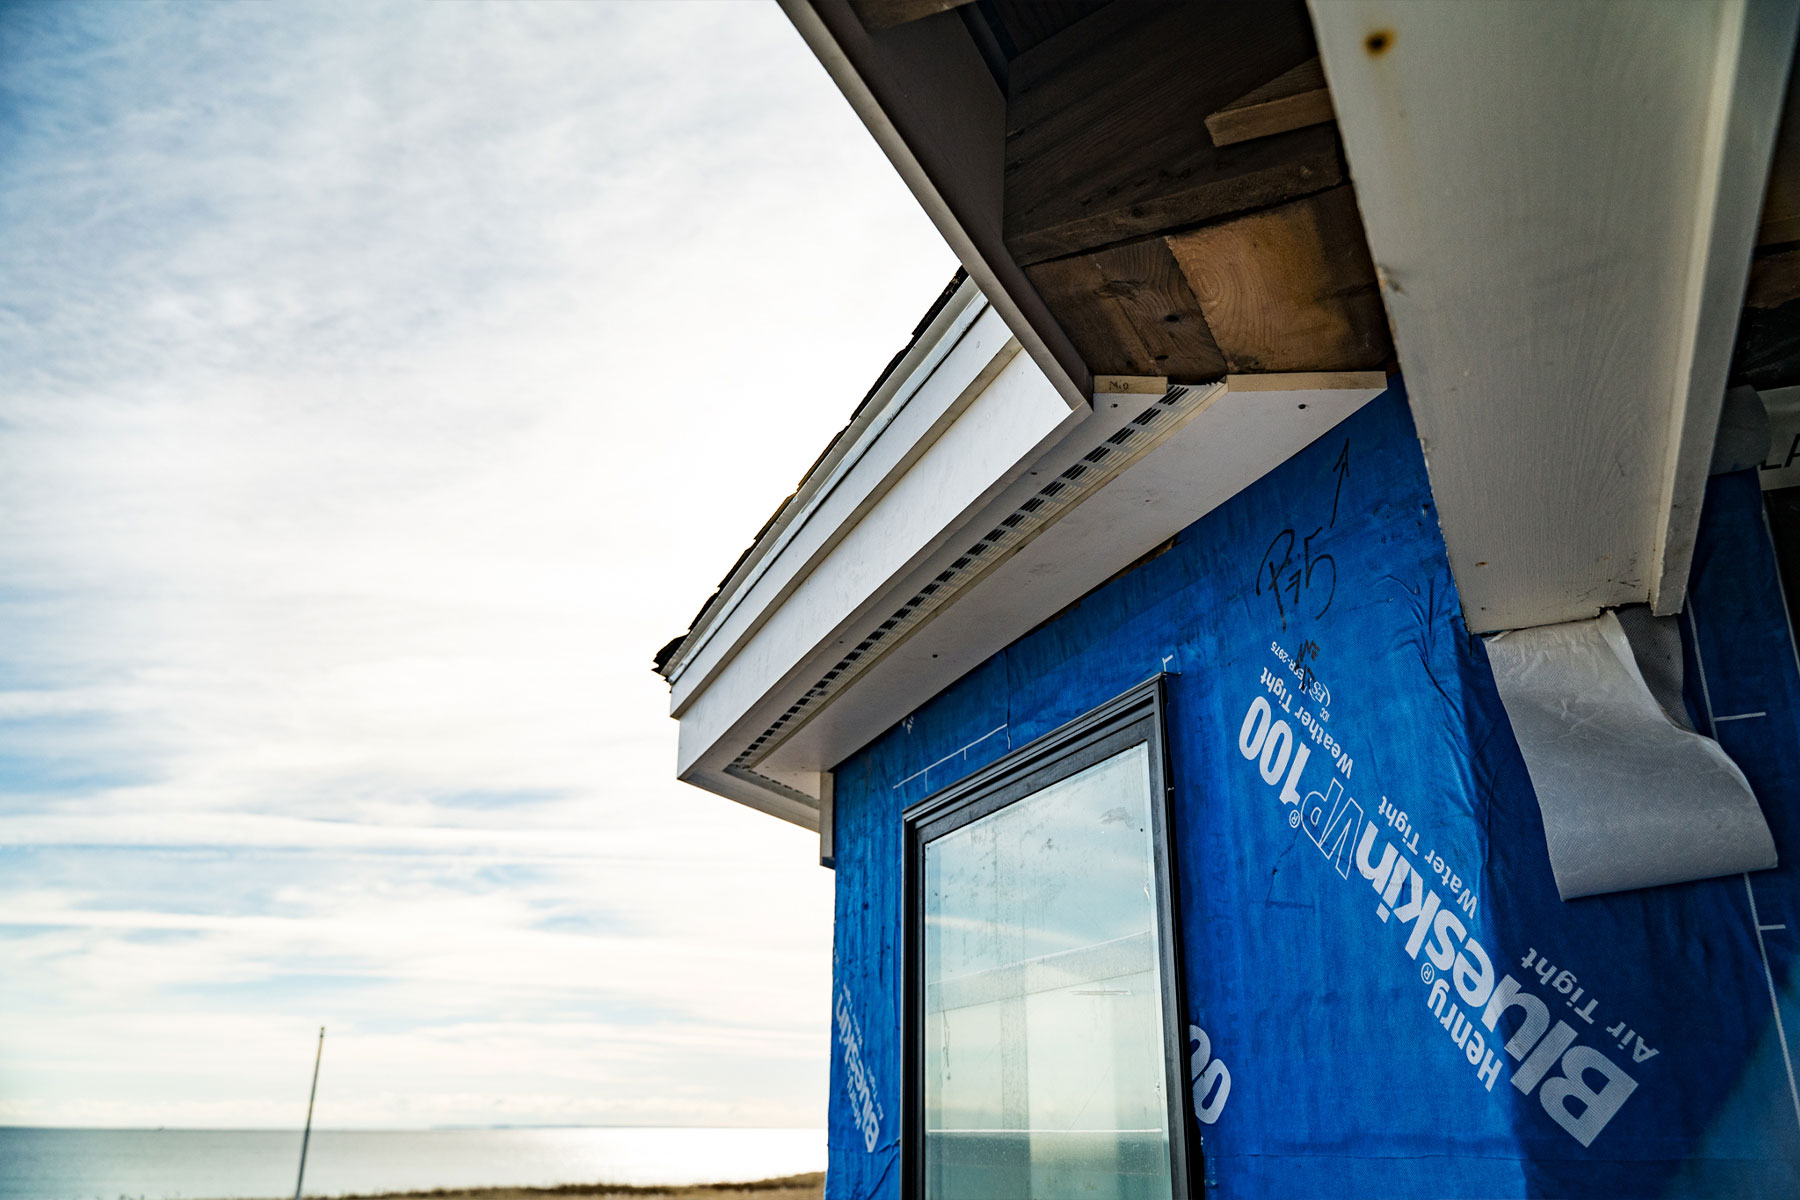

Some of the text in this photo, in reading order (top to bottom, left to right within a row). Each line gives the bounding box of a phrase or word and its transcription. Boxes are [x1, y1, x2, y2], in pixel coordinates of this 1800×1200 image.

[1260, 667, 1293, 714] Tight
[1294, 706, 1354, 779] Weather
[1378, 795, 1478, 920] Water Tight
[1356, 820, 1640, 1148] Blueskin
[1521, 947, 1660, 1064] Air Tight
[836, 992, 880, 1153] Blueskin
